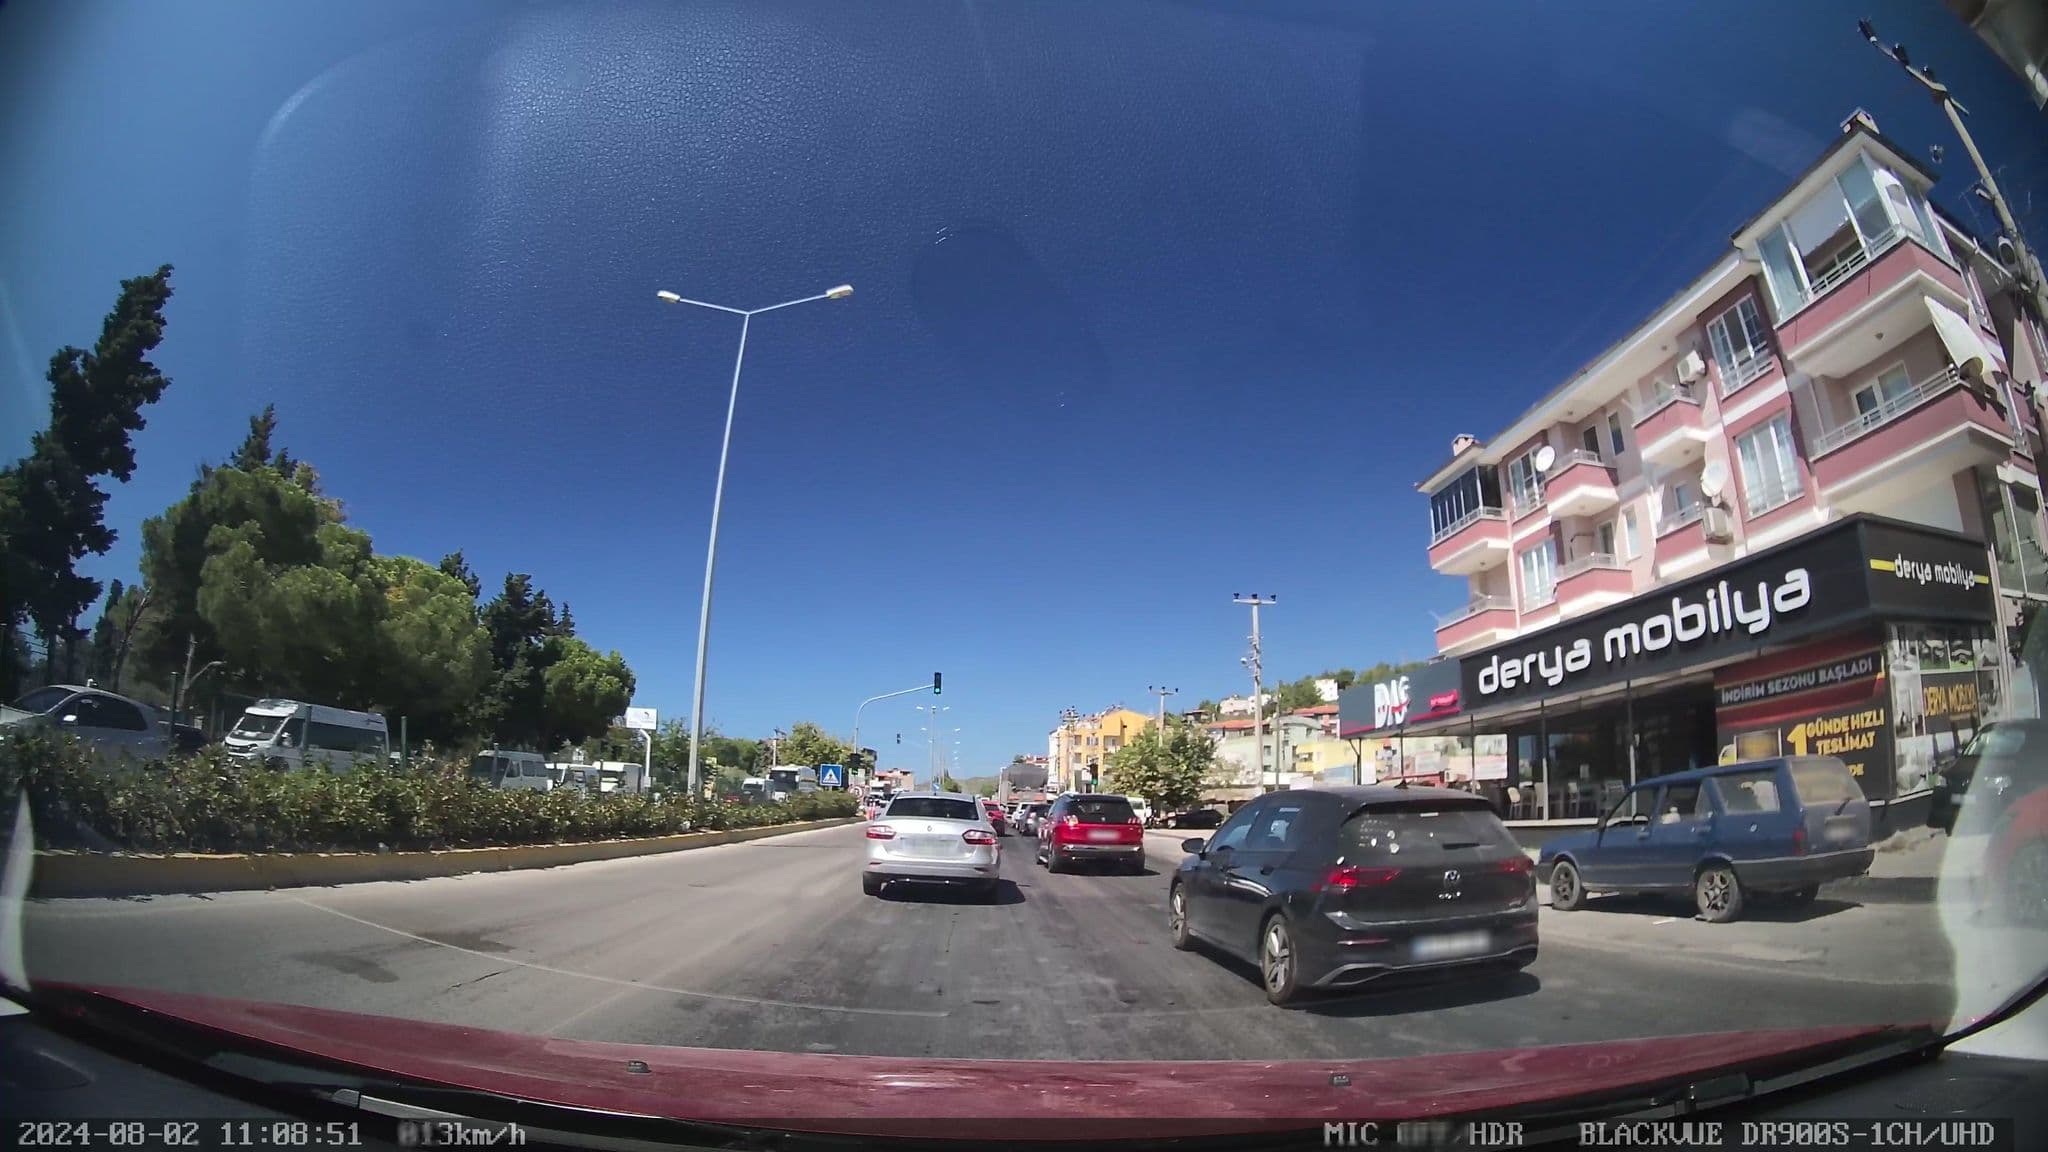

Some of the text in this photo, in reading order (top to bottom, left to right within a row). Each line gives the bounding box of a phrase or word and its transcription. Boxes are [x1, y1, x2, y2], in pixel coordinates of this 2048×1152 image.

[1895, 552, 1975, 591] derya mobilya
[1478, 567, 1812, 695] derya mobilya
[1721, 657, 1873, 705] İNDİRİM SEZONU BAŞLADI
[1786, 708, 1885, 757] 1 GÜNDE HIZLI
[1816, 731, 1876, 756] TESLİMAT
